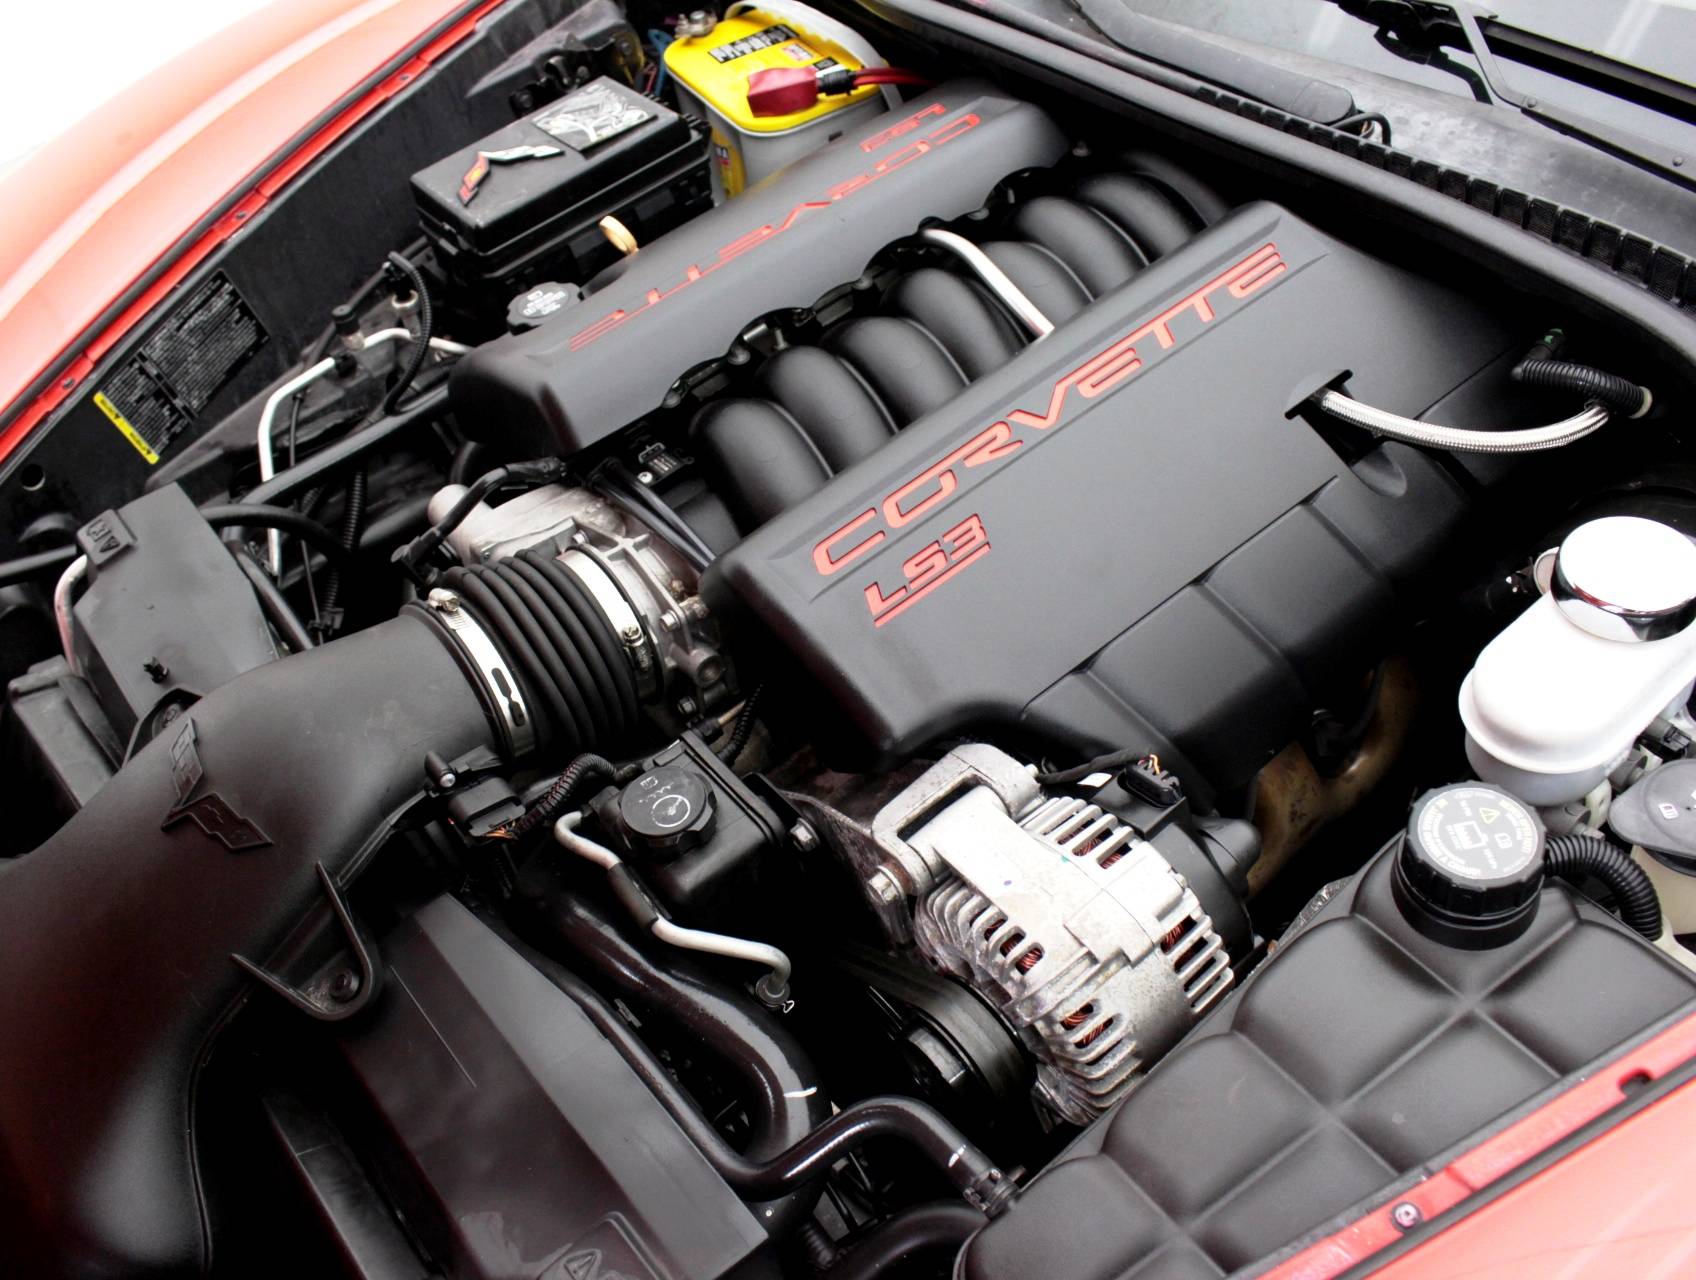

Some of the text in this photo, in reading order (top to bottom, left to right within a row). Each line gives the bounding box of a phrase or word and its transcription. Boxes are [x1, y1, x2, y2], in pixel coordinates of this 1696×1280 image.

[568, 113, 981, 353] CORVETTE
[812, 242, 1288, 577] CORVETTE
[863, 513, 991, 620] LS3
